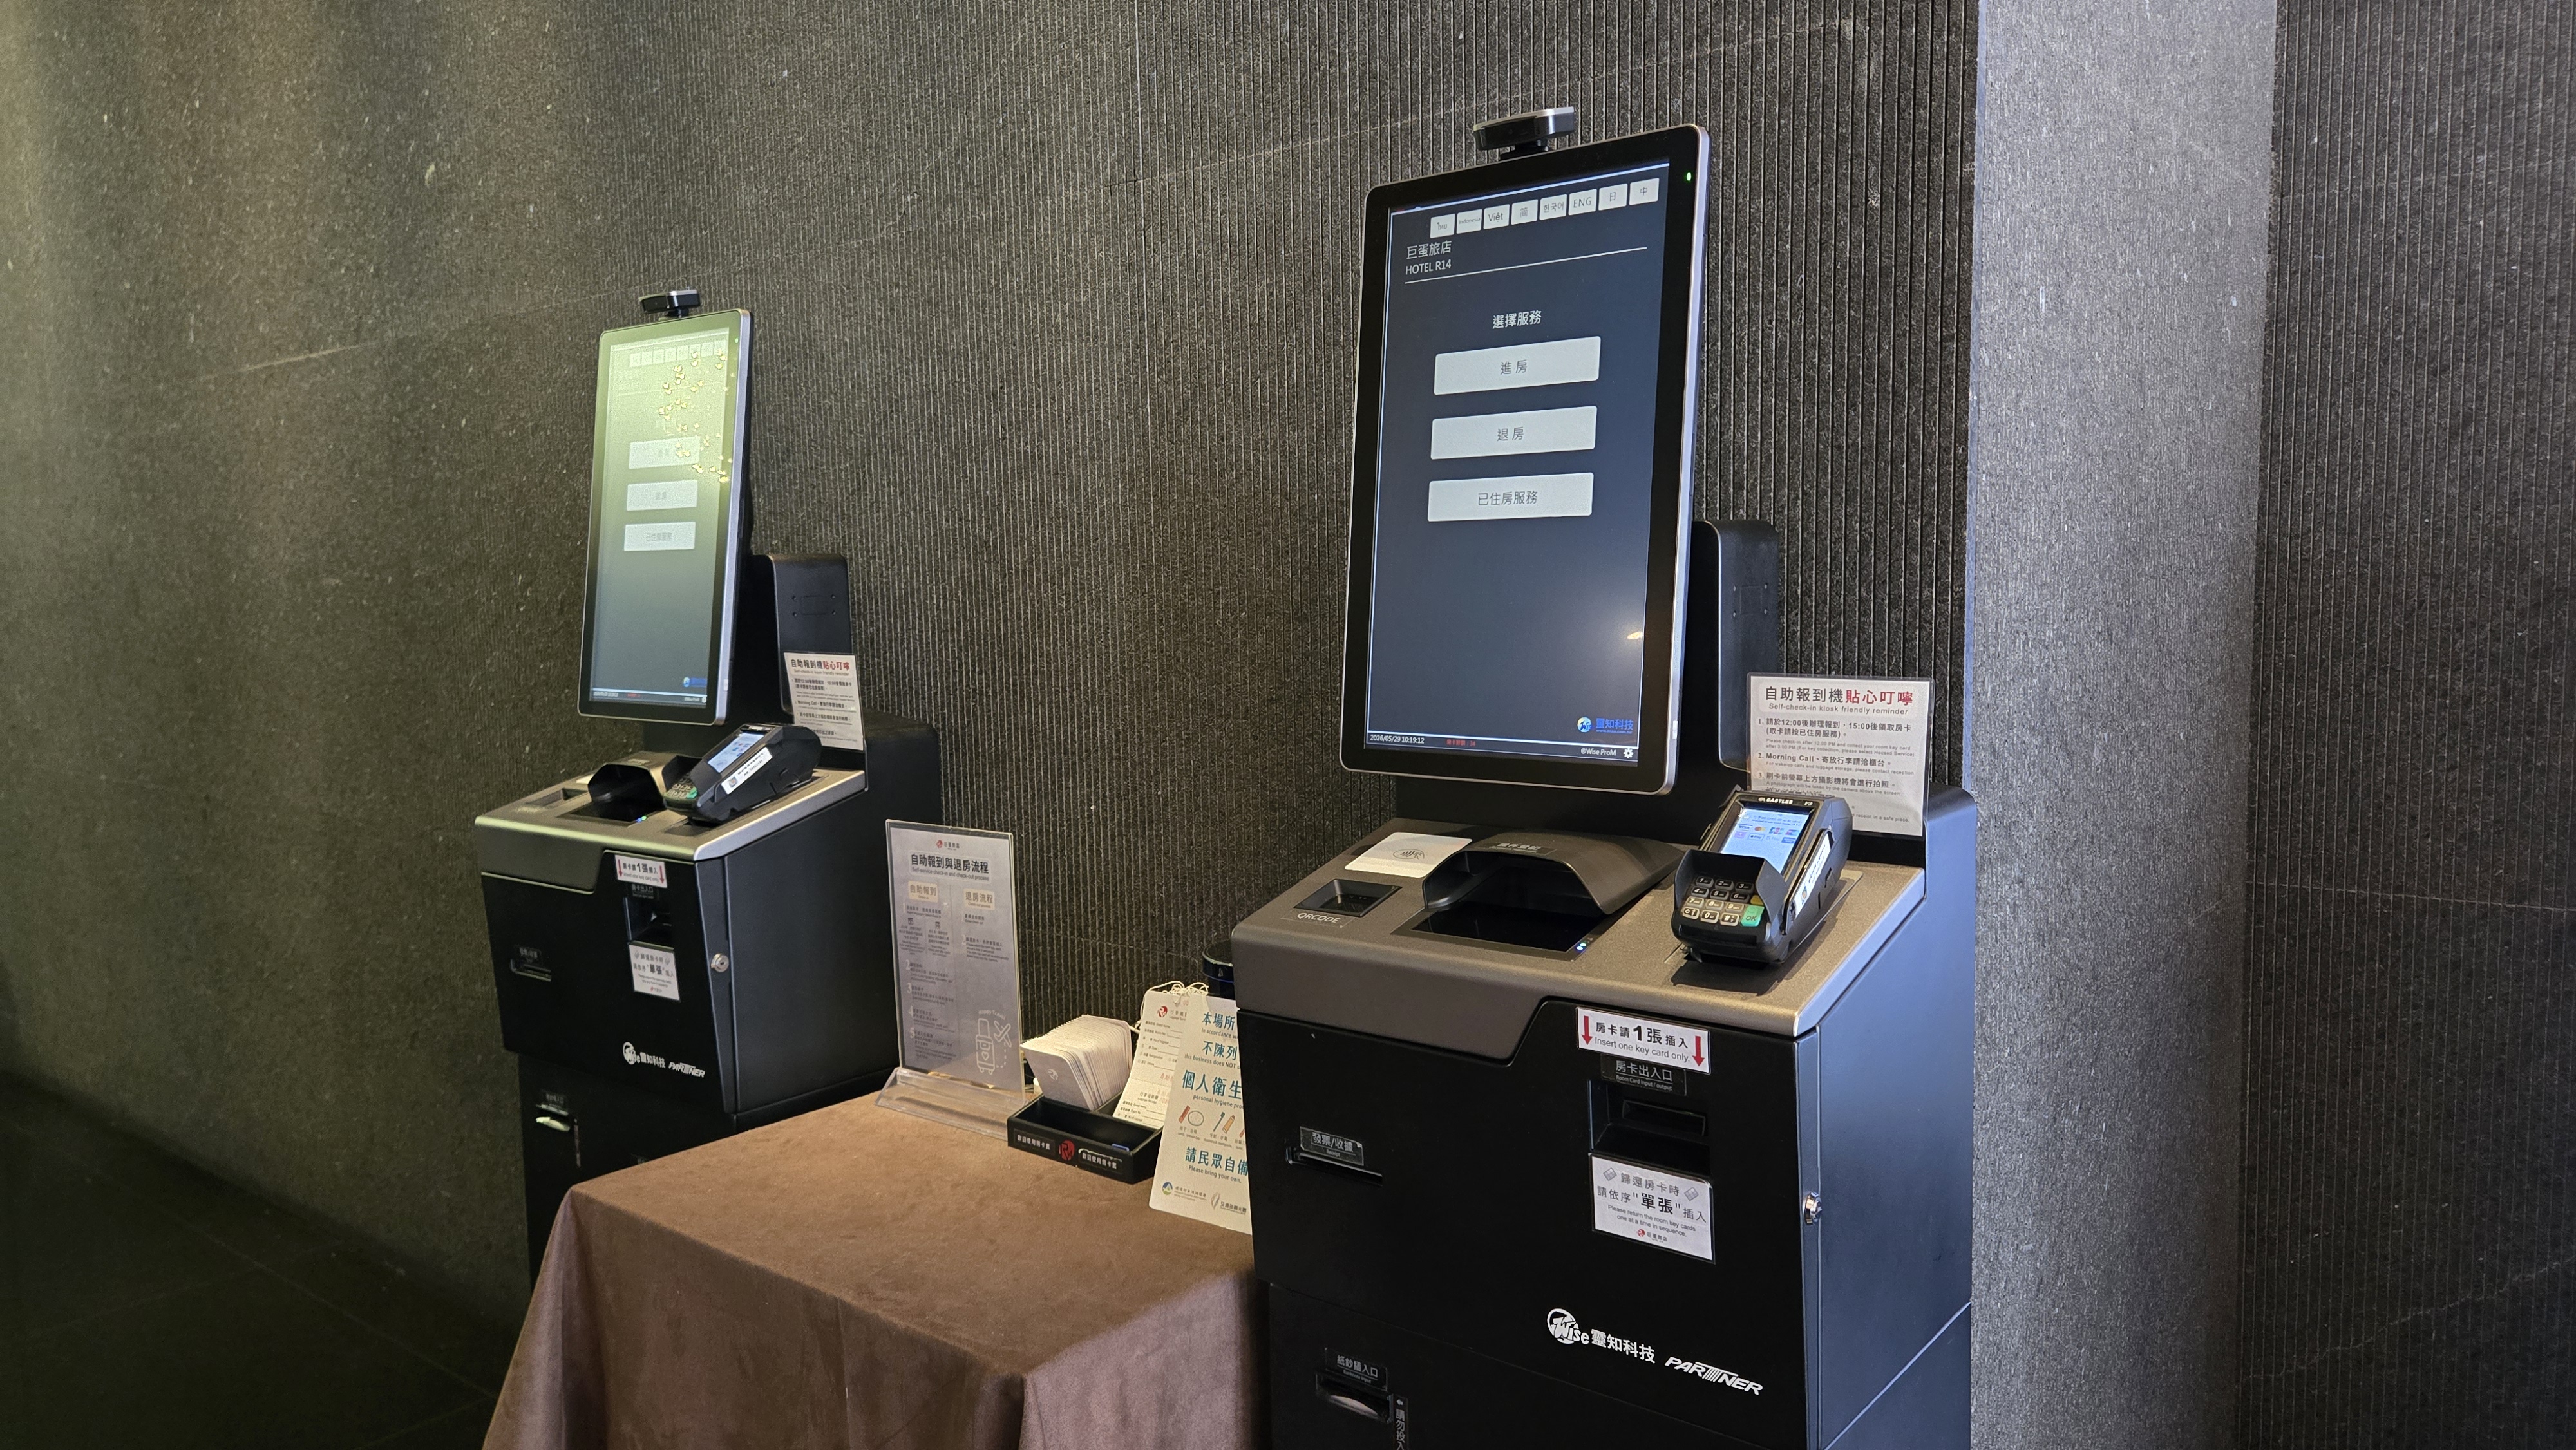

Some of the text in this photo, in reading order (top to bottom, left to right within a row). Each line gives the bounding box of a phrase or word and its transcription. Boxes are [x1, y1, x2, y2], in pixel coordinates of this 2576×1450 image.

[1609, 192, 1616, 202] 日
[1640, 187, 1647, 196] 中
[1543, 202, 1564, 214] 한국어
[1573, 197, 1591, 208] ENG
[1488, 212, 1504, 222] Việt
[1406, 241, 1452, 259] 巨蛋旅店
[1405, 259, 1452, 275] HOTEL R14
[1492, 310, 1542, 329] 選擇服務
[1478, 491, 1538, 506] 已住房服務
[1765, 686, 1913, 706] 自助報到機貼心叮嚀
[1370, 734, 1425, 744] 2026/05/29 10:19:12
[1766, 753, 1796, 762] Morning
[911, 854, 989, 874] 自助報到與退房流程
[910, 884, 992, 903] 自助報到 退房流程
[1298, 912, 1341, 925] QRCODE
[1202, 1012, 1235, 1030] 本場所
[1207, 1030, 1231, 1039] accordance
[1596, 1022, 1688, 1049] 房卡請1張插入
[1202, 1040, 1237, 1061] 不陳列
[1595, 1037, 1690, 1062] Insert one key card only.
[1193, 1055, 1212, 1064] business
[668, 1062, 705, 1078] PARTNER
[1616, 1060, 1672, 1082] 房卡出入口
[1193, 1094, 1233, 1107] personal hygiene
[1185, 1147, 1248, 1176] 請民眾自備
[1188, 1165, 1204, 1174] Please
[1204, 1169, 1217, 1178] bring
[1621, 1173, 1679, 1196] 歸還房卡時
[1608, 1205, 1626, 1214] Please
[1681, 1223, 1696, 1232] cards
[1659, 1225, 1687, 1237] sequence.
[1553, 1317, 1590, 1344] Wise
[1665, 1356, 1763, 1395] PARTNER
[1337, 1355, 1378, 1378] 紙鈔插入口
